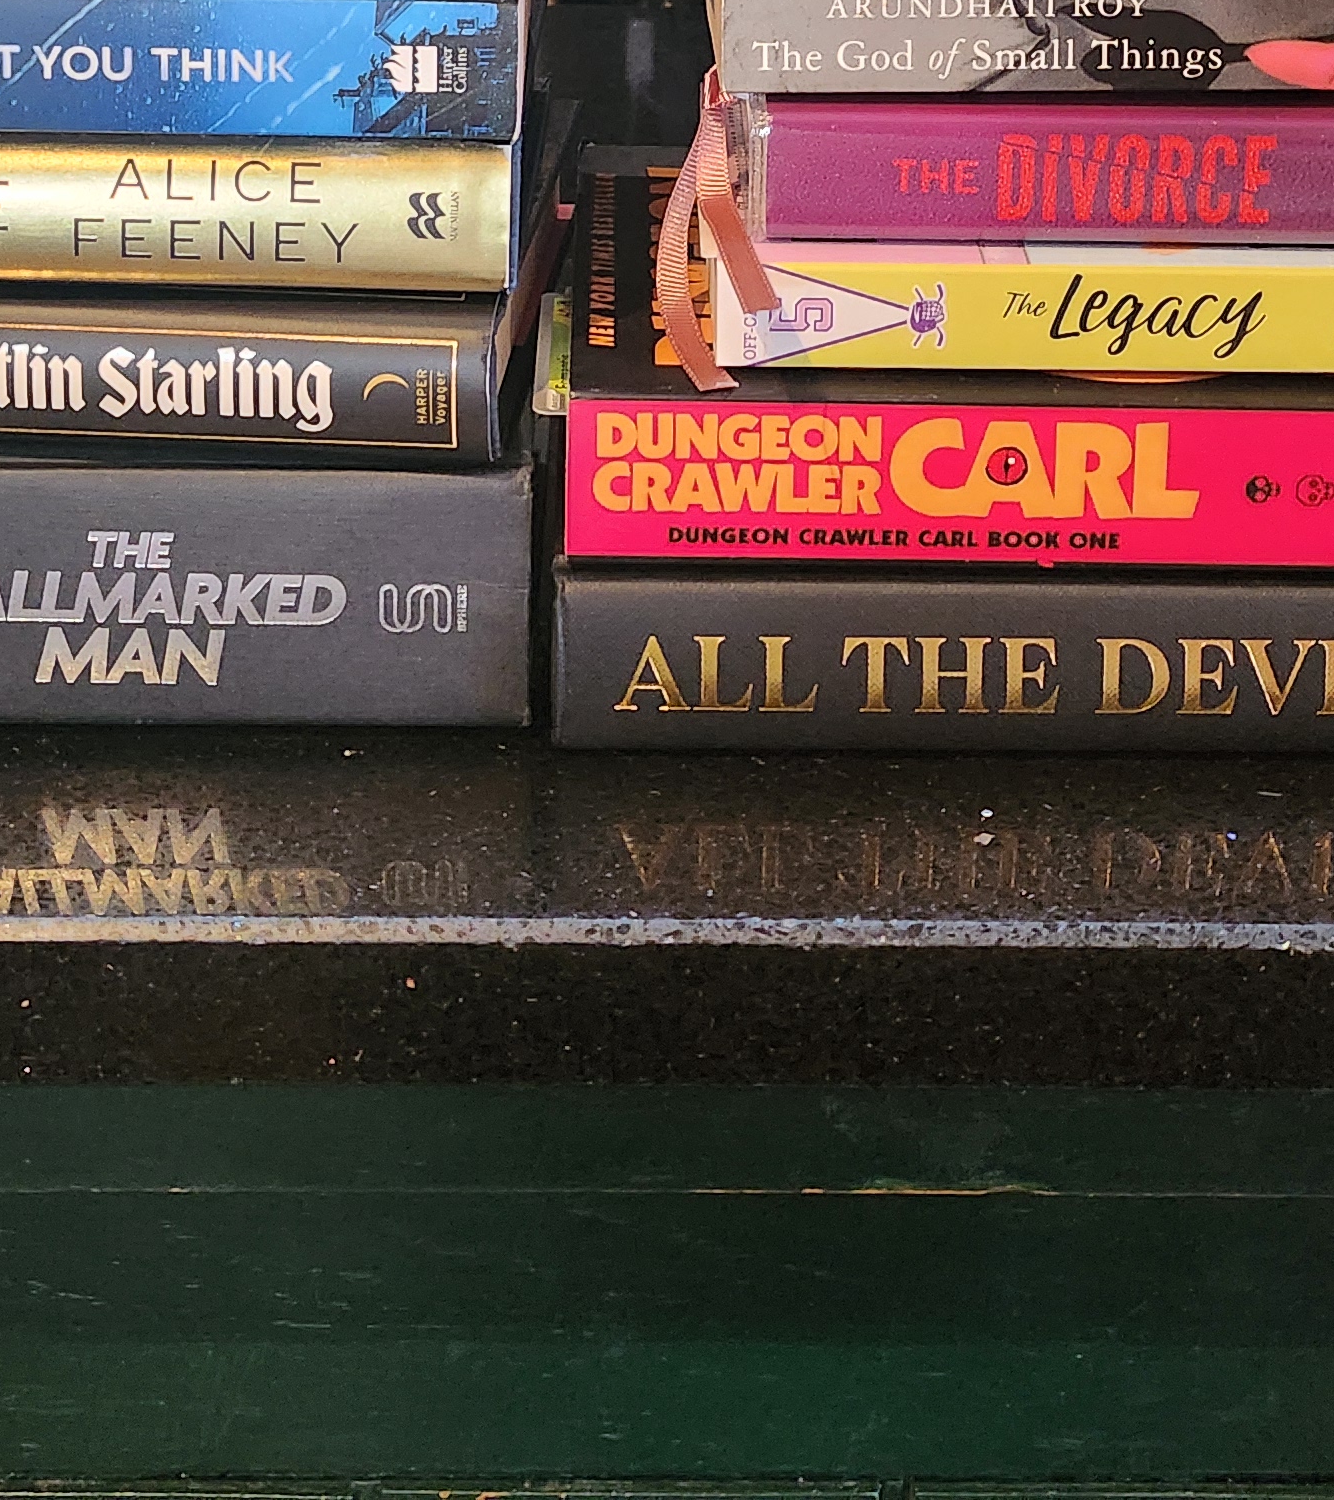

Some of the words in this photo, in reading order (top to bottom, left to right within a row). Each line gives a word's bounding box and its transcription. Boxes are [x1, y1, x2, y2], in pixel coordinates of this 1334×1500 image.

[35, 44, 133, 83] YOU
[150, 46, 295, 84] THINK
[438, 47, 455, 94] Harper
[452, 46, 470, 94] Collins
[752, 41, 823, 73] The
[836, 38, 915, 73] God
[928, 37, 963, 80] of
[970, 38, 1077, 72] Small
[1091, 39, 1223, 79] Things
[109, 158, 323, 205] ALICE
[892, 158, 979, 196] THE
[996, 132, 1277, 225] DIVORCE
[73, 217, 360, 264] FEENEY
[589, 276, 615, 310] YORK
[1003, 290, 1047, 319] The
[1050, 273, 1266, 359] Legacy
[588, 314, 615, 347] NEW
[97, 344, 334, 433] Starling
[417, 368, 429, 424] HARPER
[434, 370, 450, 426] Voyager
[595, 412, 883, 462] DUNGEON
[592, 462, 882, 515] CRAWLER
[889, 416, 1200, 521] CARL
[86, 531, 175, 569] THE
[668, 526, 789, 546] DUNGEON
[799, 527, 909, 547] CRAWLER
[918, 528, 978, 548] CARL
[988, 530, 1060, 549] BOOK
[1069, 532, 1120, 550] ONE
[34, 627, 226, 687] MAN
[614, 634, 819, 713] ALL
[841, 635, 1060, 715] THE
